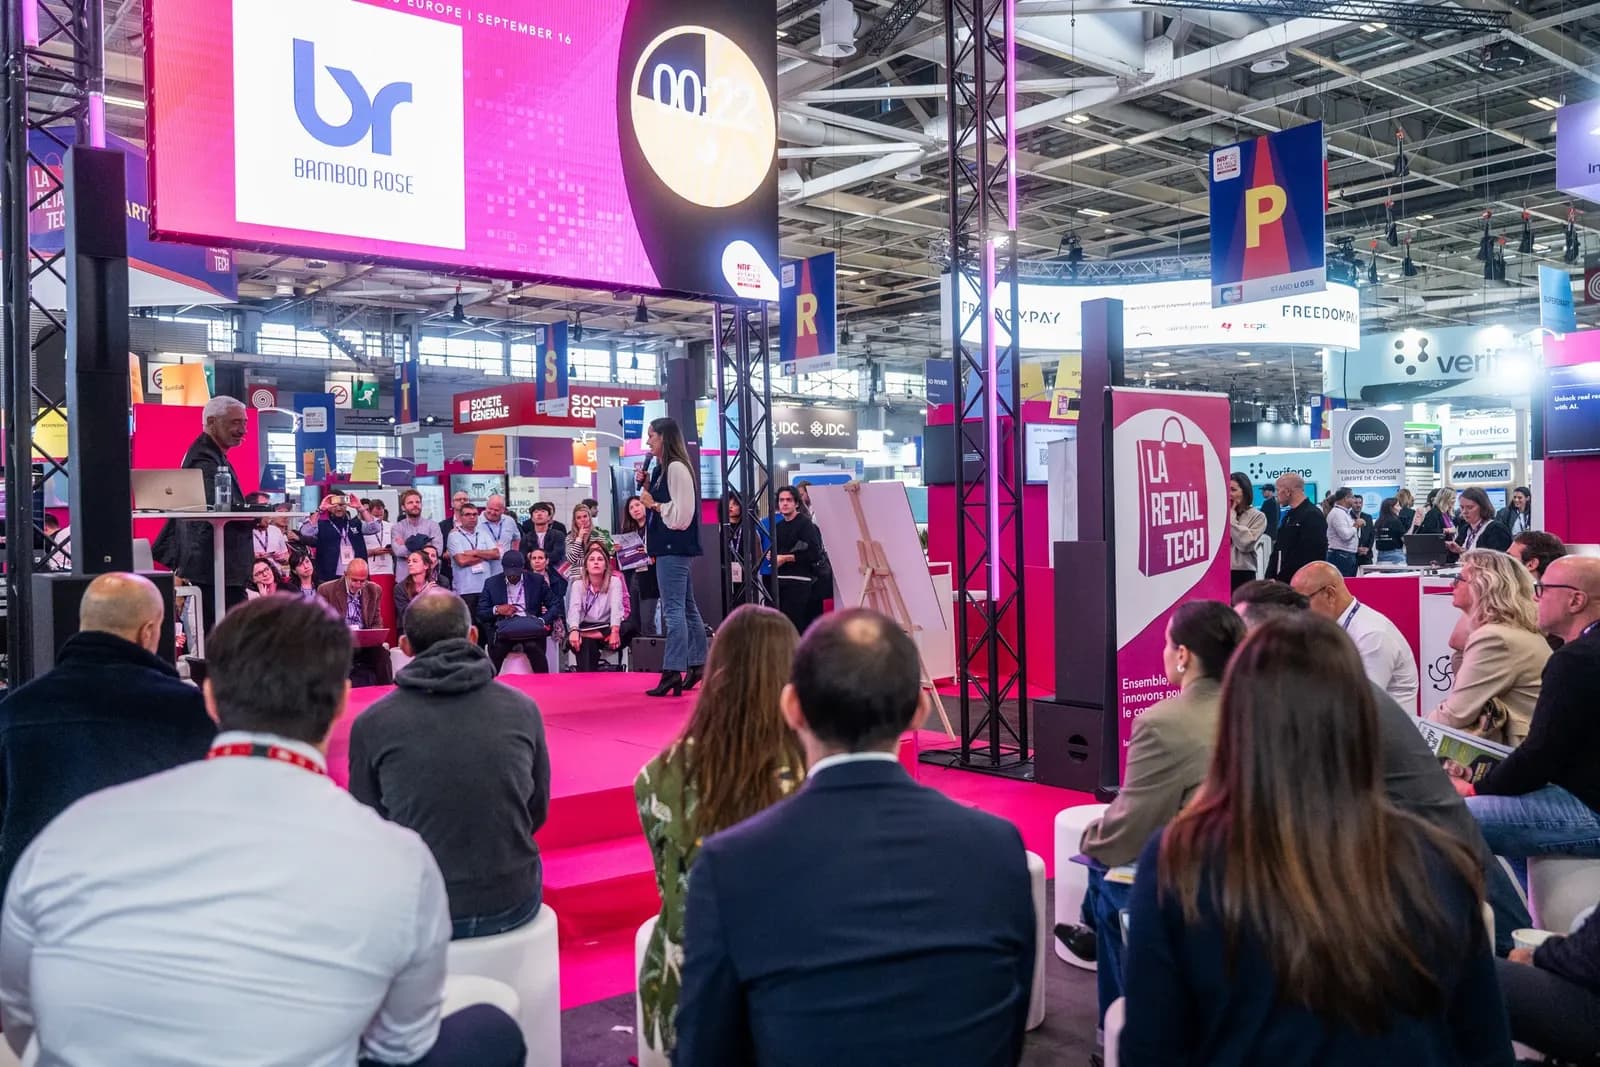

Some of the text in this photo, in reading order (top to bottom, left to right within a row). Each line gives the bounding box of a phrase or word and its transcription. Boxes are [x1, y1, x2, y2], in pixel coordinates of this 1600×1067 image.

[477, 12, 553, 39] SEPTEMBER
[558, 32, 572, 45] 16
[295, 157, 414, 195] BAMBOO ROSE
[1244, 184, 1288, 249] P
[796, 293, 818, 337] R
[545, 350, 557, 383] S
[400, 383, 410, 410] T
[471, 395, 502, 410] SOCIETE
[1554, 394, 1577, 402] Unlock
[471, 406, 510, 422] GENERALE
[824, 423, 846, 436] JDC
[1354, 434, 1385, 443] ingenico
[1147, 448, 1169, 483] LA
[1468, 469, 1510, 478] MONEXT
[1150, 485, 1204, 527] RETAIL
[1163, 527, 1205, 567] TECH
[1122, 674, 1170, 690] Ensemble,
[1122, 690, 1164, 704] innovons
[1122, 706, 1132, 719] le
